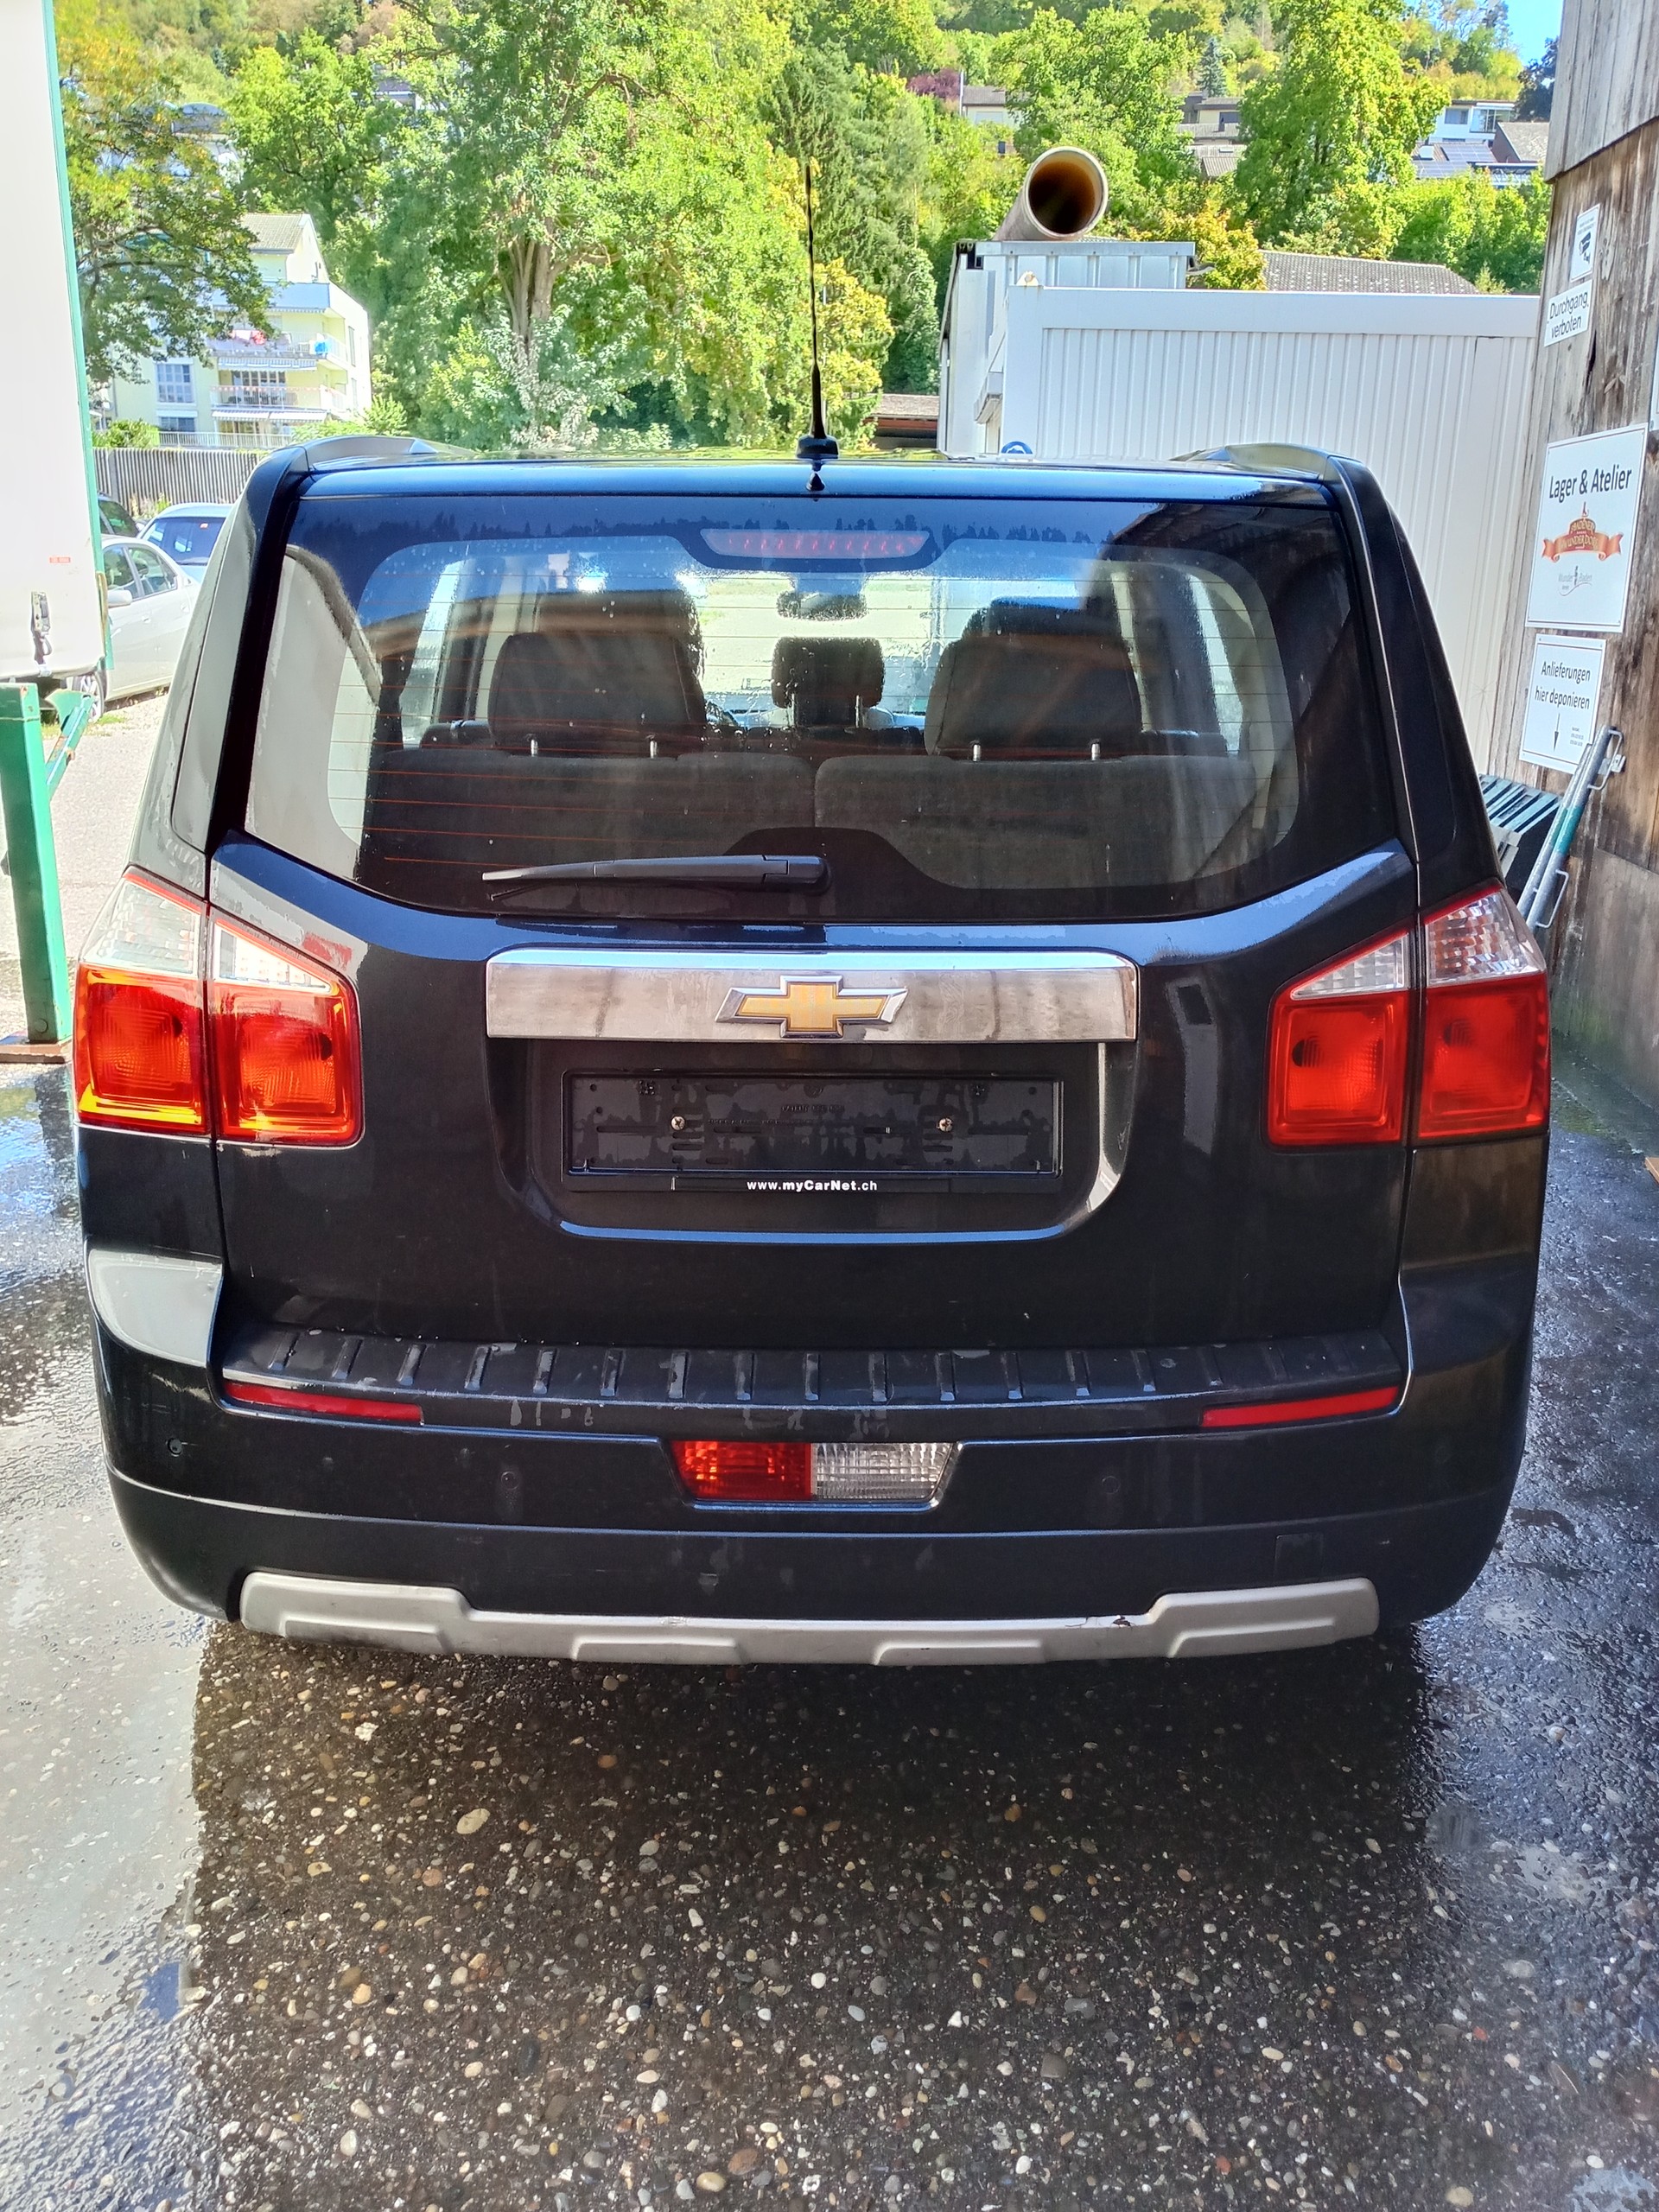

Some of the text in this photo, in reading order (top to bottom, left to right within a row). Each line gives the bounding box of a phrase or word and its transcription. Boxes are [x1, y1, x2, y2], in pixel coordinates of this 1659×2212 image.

[1549, 292, 1588, 320] Durchgang
[1551, 315, 1582, 339] verboten
[1549, 463, 1632, 503] Lager & Atelier
[1541, 661, 1591, 684] Anlieferungen
[1535, 685, 1590, 710] hier deponieren
[747, 1179, 878, 1192] www.myCarNet.ch
